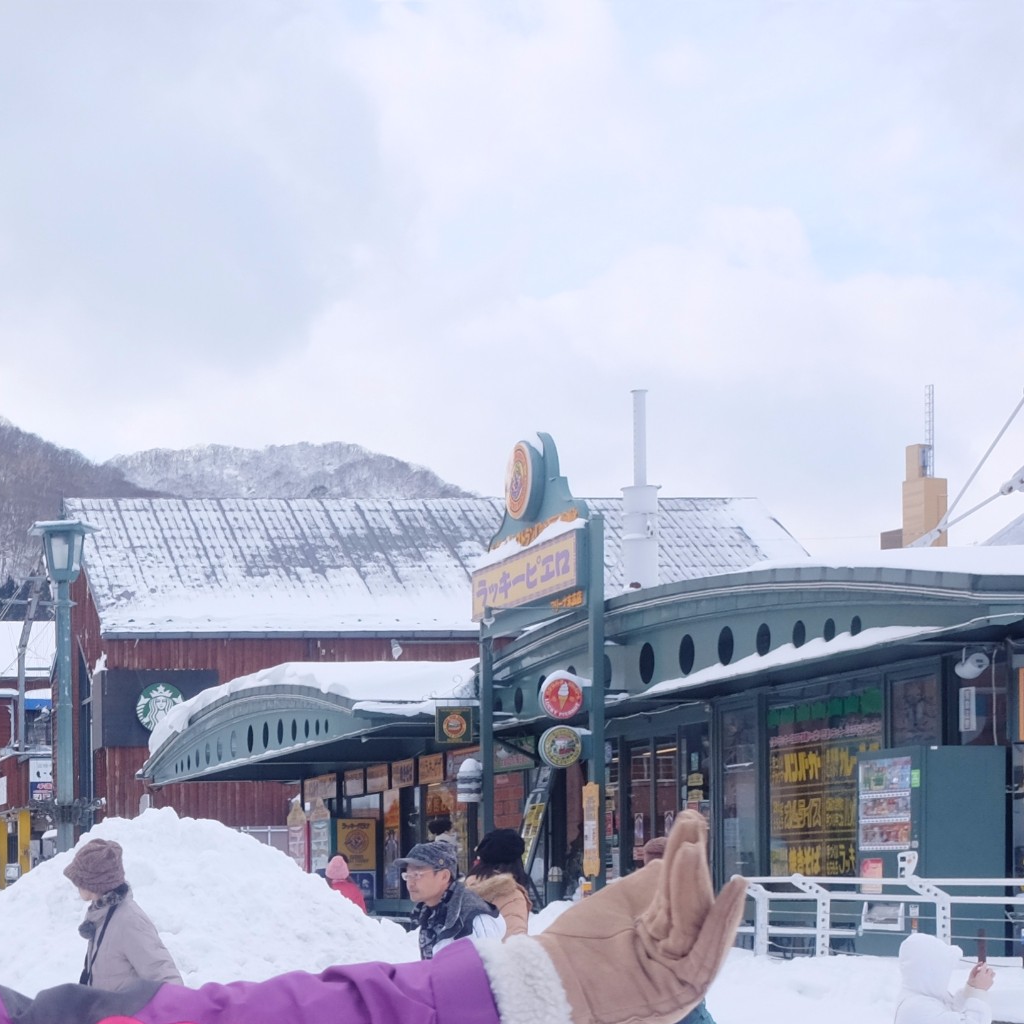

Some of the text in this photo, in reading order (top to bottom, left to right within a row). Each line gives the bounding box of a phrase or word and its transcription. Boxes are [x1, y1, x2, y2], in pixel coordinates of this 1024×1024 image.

[476, 548, 571, 608] ラッキーピエロ
